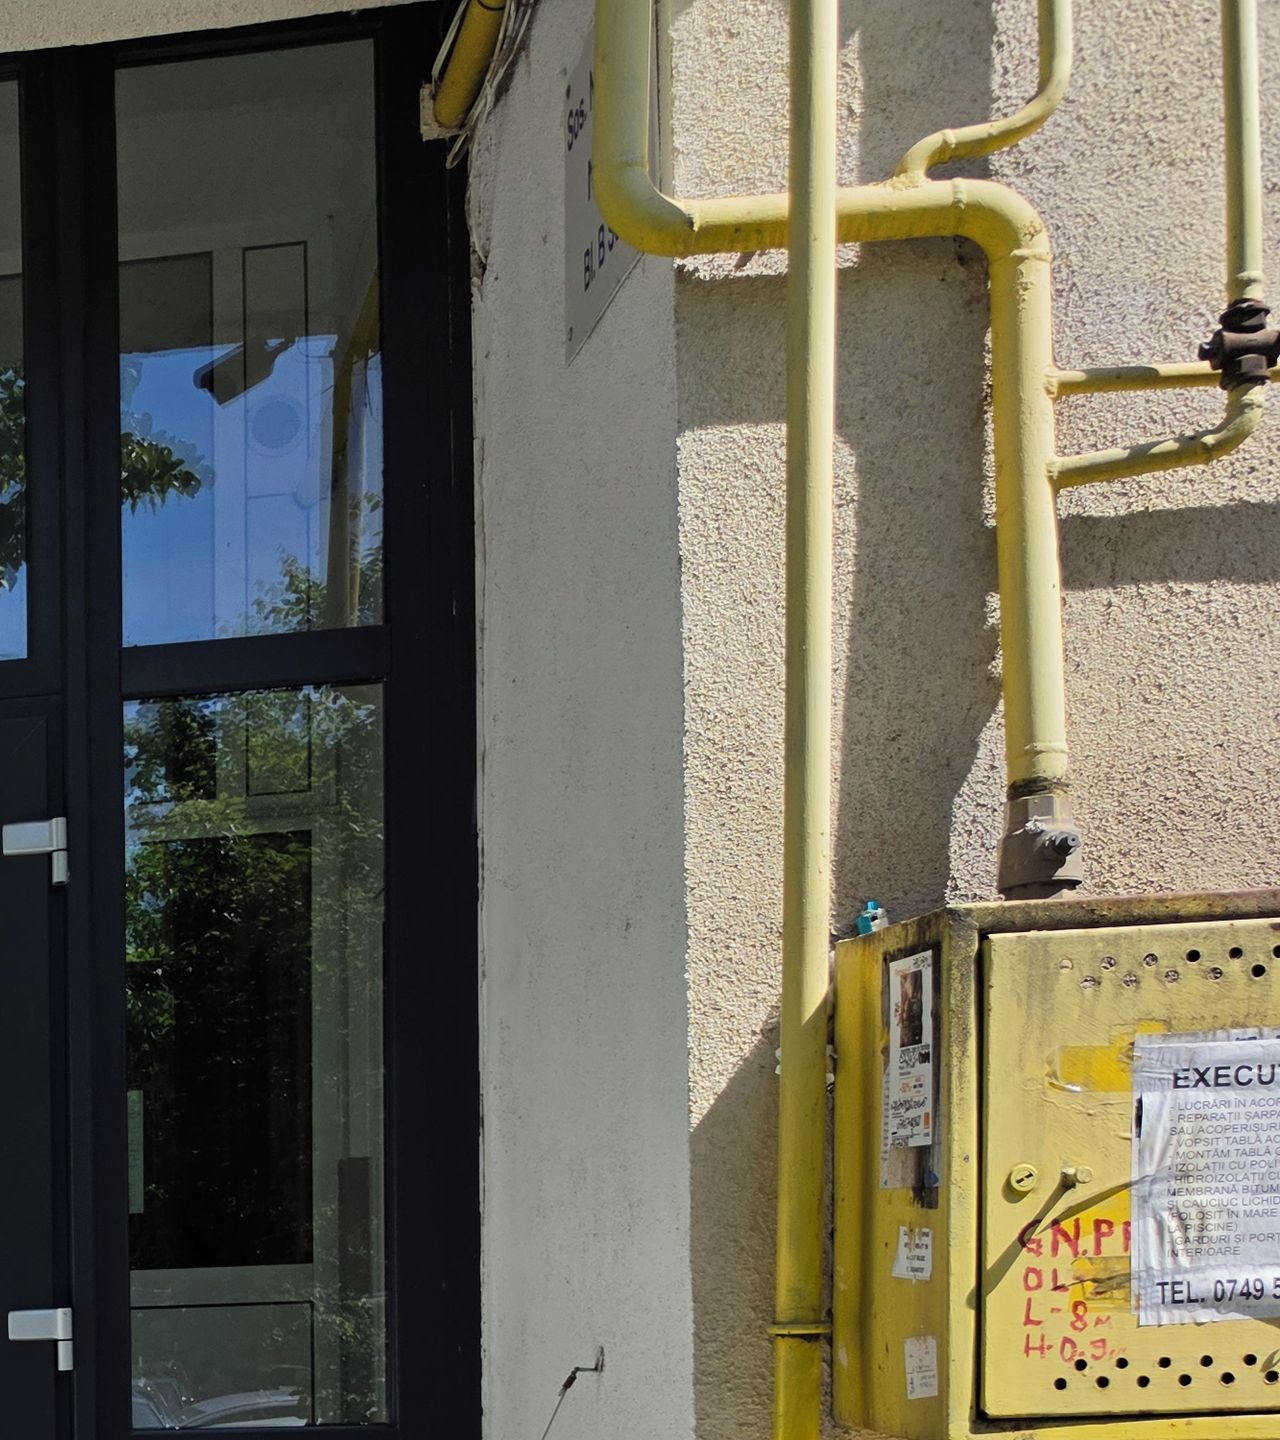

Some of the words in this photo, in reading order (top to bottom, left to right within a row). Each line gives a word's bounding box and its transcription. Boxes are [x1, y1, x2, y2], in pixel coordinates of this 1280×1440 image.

[1172, 1063, 1280, 1090] EXECU
[1169, 1125, 1195, 1136] SAU
[1176, 1136, 1222, 1148] VOPSIT
[1228, 1160, 1246, 1170] CU
[1182, 1197, 1239, 1209] CAUCIUC
[1242, 1207, 1278, 1219] MARE
[1175, 1234, 1231, 1246] GARDURI
[1167, 1246, 1241, 1258] INTERIOARE
[1156, 1280, 1206, 1304] TEL.
[1213, 1278, 1265, 1302] 0749
